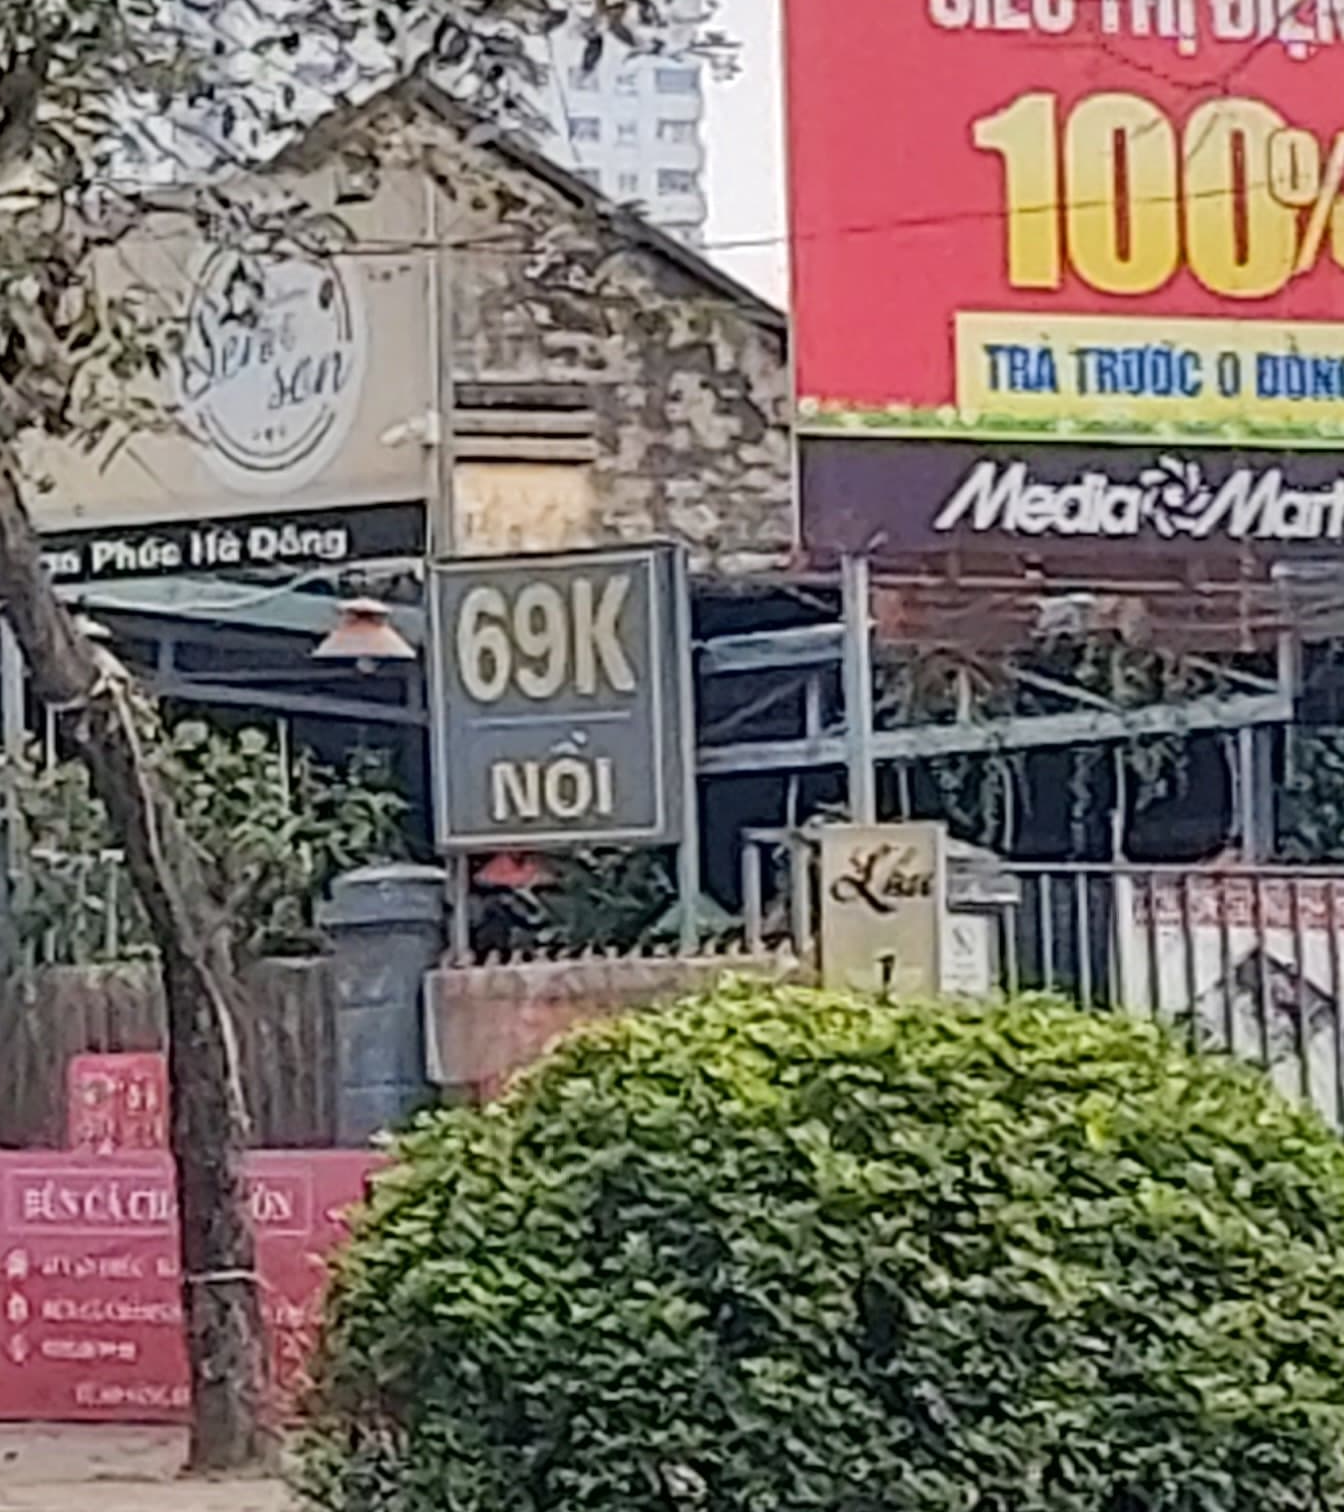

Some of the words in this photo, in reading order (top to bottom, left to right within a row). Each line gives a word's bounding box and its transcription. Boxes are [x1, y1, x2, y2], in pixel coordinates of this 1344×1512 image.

[934, 461, 1142, 535] Media
[457, 574, 636, 702] 69K
[491, 729, 613, 822] NỒI
